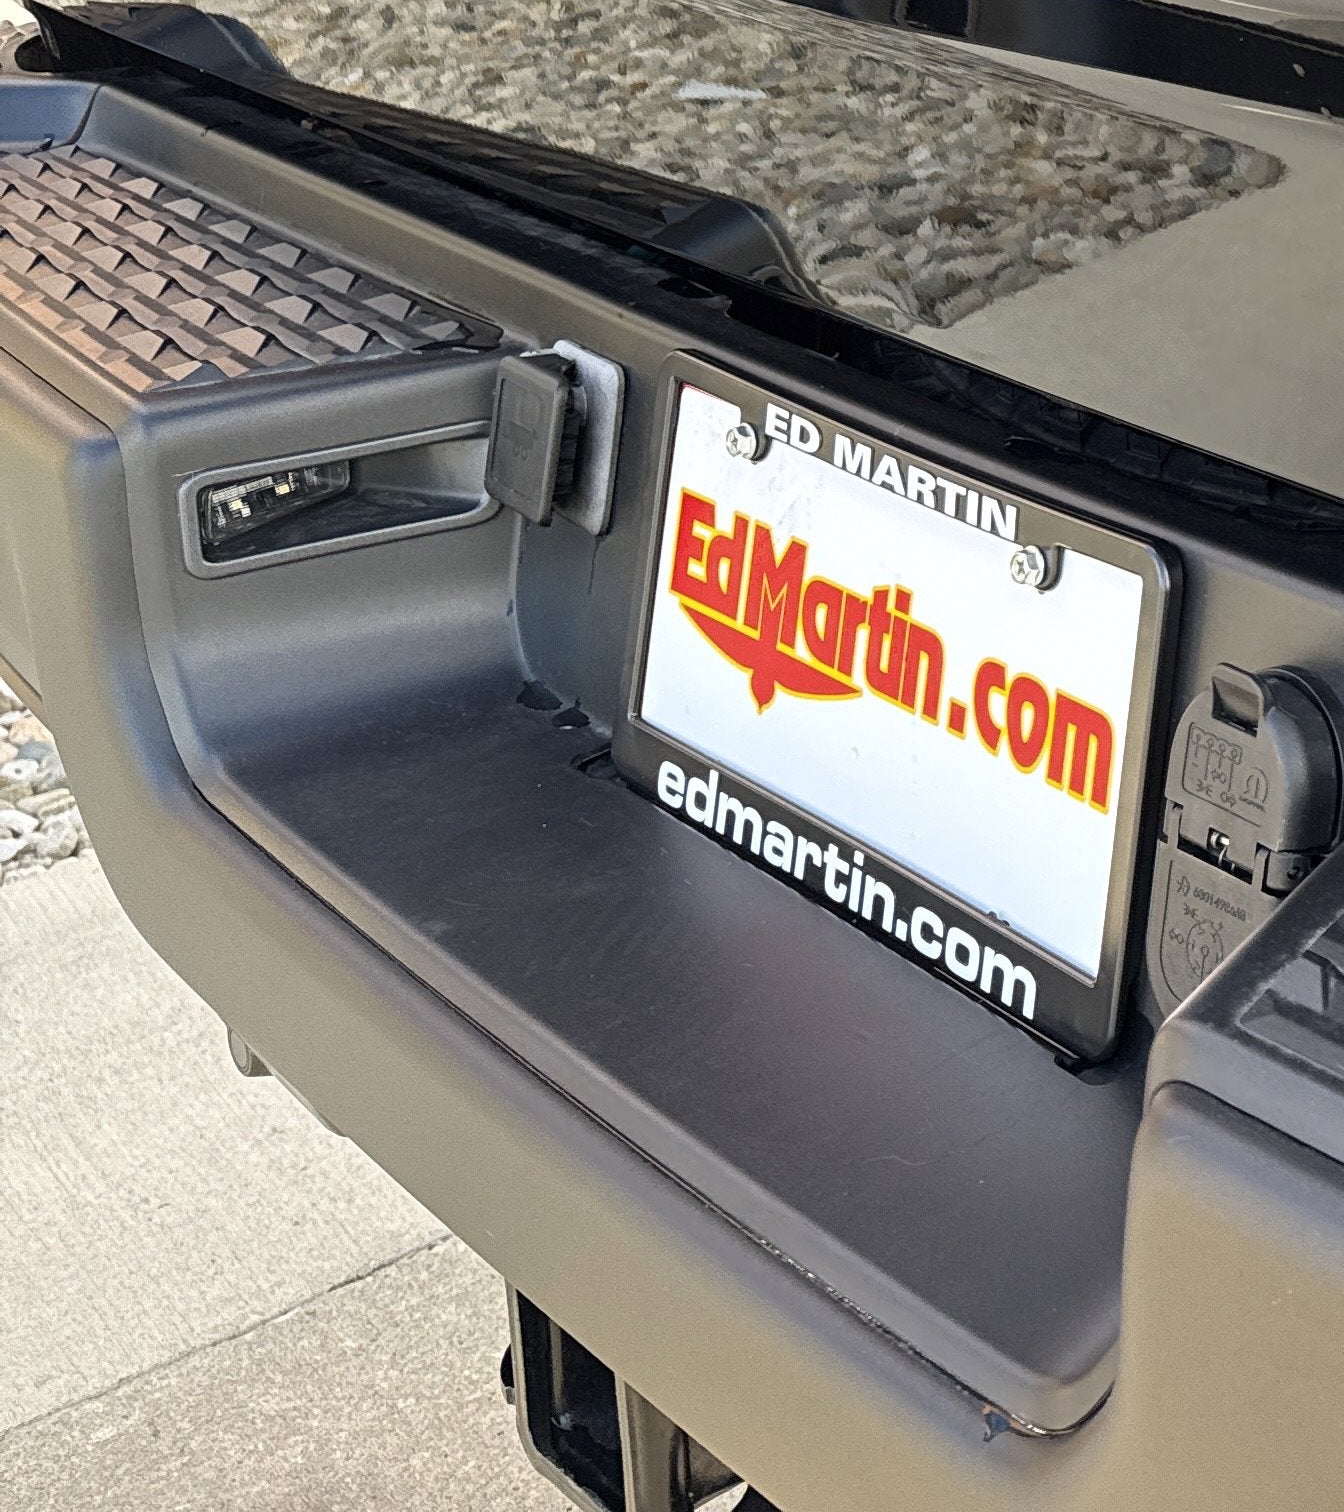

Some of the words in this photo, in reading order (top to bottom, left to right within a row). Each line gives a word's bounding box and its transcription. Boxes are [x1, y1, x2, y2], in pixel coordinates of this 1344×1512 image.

[764, 402, 823, 455] ED
[833, 432, 1021, 543] MARTIN
[669, 486, 1115, 815] EdMartin.com
[656, 758, 1038, 1021] edmartin.com
